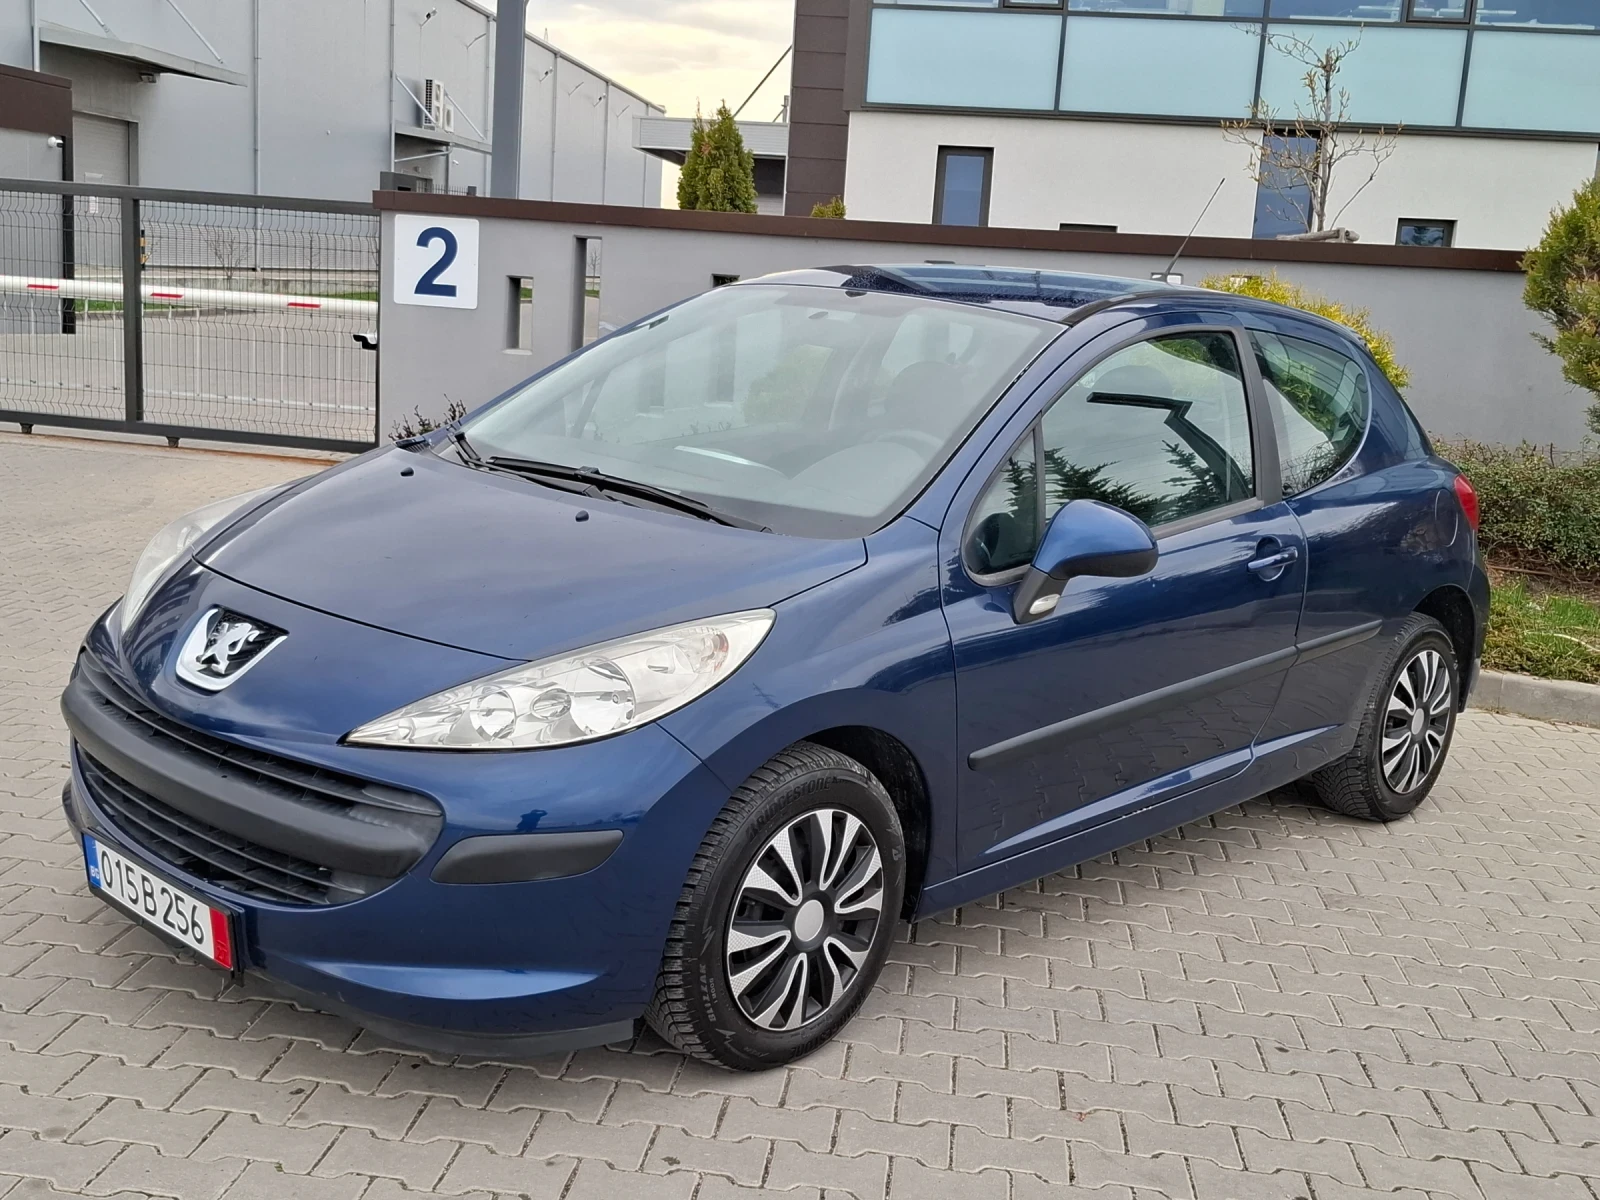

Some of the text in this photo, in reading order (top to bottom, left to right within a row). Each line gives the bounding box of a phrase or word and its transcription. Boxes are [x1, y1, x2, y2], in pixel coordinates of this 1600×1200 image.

[414, 226, 458, 297] 2
[91, 866, 100, 880] BG
[101, 850, 205, 945] 015B256
[699, 964, 717, 1022] BLIZZAK
